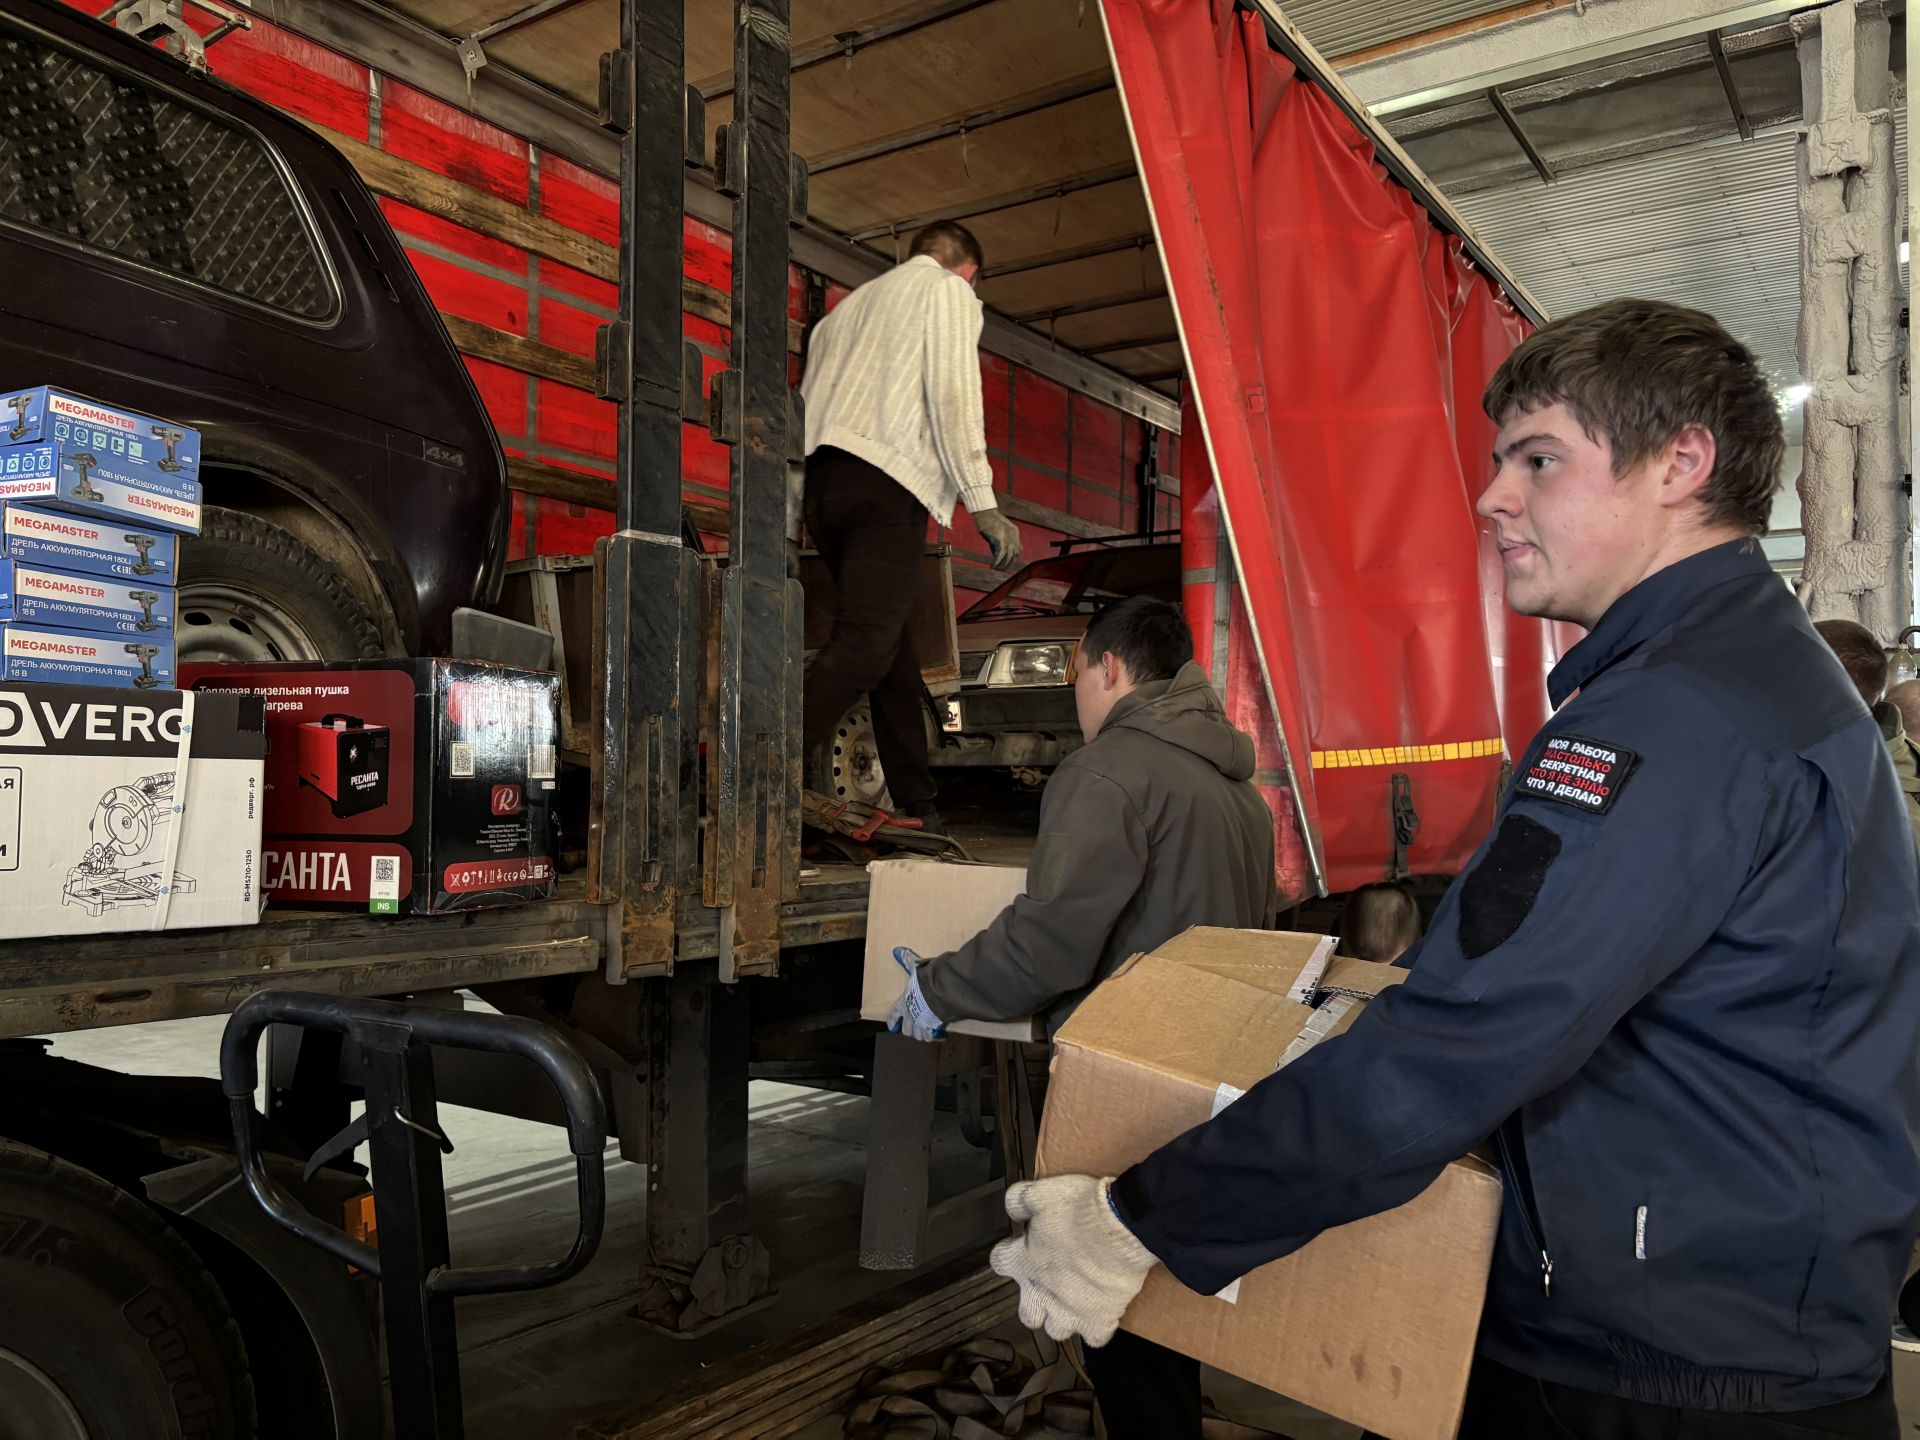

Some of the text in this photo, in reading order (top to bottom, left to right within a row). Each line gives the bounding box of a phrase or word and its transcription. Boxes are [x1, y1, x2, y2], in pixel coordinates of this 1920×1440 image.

[55, 400, 136, 430] MEGAMASTER
[127, 494, 194, 518] MEGAMASTER
[14, 516, 99, 540] MEGAMASTER
[12, 538, 39, 549] ДРЕЛЬ
[40, 544, 113, 562] АККУМУЛЯТОРНАЯ
[26, 578, 105, 598] MEGAMASTER
[22, 599, 49, 610] ДРЕЛЬ
[50, 604, 118, 620] АККУМУЛЯТОРНАЯ
[22, 608, 30, 616] 18
[10, 639, 97, 656] MEGAMASTER
[10, 660, 38, 668] ДРЕЛЬ
[40, 662, 112, 676] АККУМУЛЯТОРНАЯ
[200, 686, 350, 698] Тепловая дизельная пушка
[266, 701, 304, 712] агрева
[1544, 749, 1612, 773] НАСТОЛЬКО
[1548, 739, 1616, 764] МОЯ РАБОТА
[350, 771, 379, 786] РЕСАНТА
[1530, 767, 1610, 796] ЧТО Я НЕ ЗНАЮ
[1540, 759, 1606, 784] СЕКРЕТНАЯ
[0, 778, 14, 790] Я
[1526, 776, 1603, 806] ЧТО Я ДЕЛАЮ
[244, 850, 252, 902] RD-MS210-1250
[261, 852, 352, 891] САНТА
[377, 902, 390, 910] INS
[122, 1286, 218, 1440] Cordi
